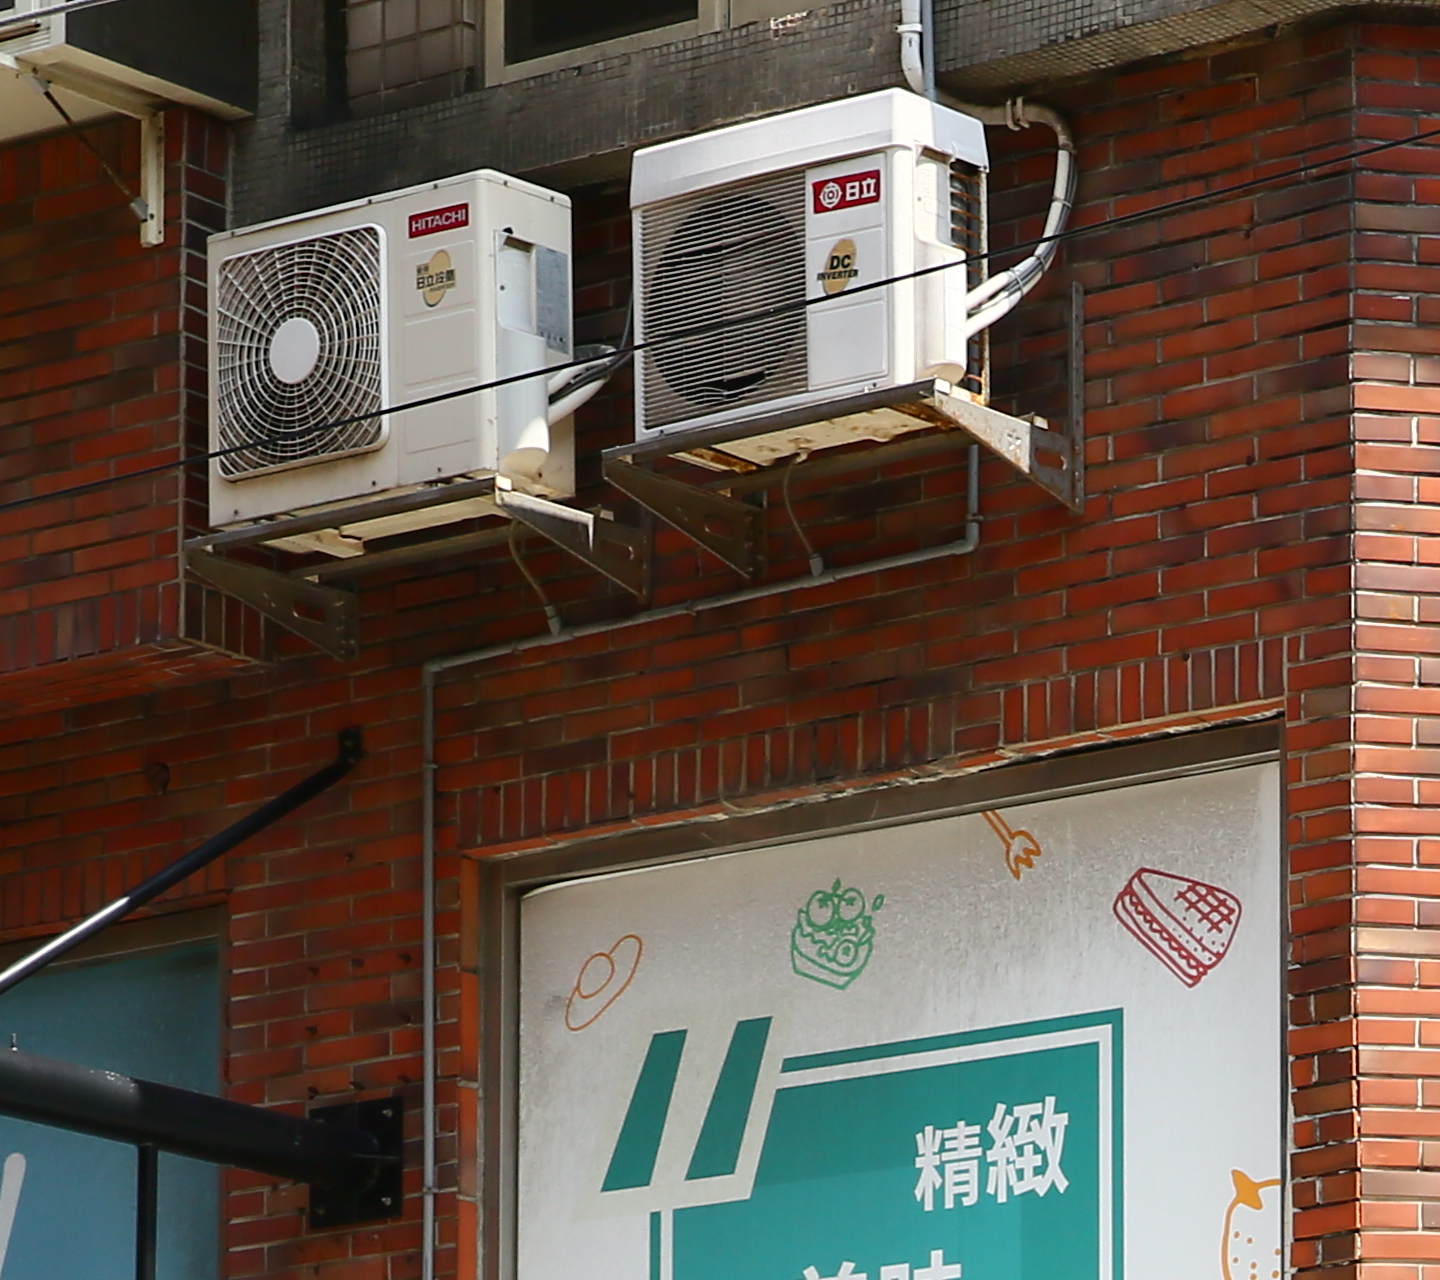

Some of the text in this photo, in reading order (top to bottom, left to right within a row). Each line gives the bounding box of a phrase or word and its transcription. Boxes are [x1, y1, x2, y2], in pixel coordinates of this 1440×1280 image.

[845, 177, 877, 202] 日立
[411, 208, 467, 234] HITACHI
[829, 254, 852, 271] DC
[913, 1094, 1072, 1213] 精緻
